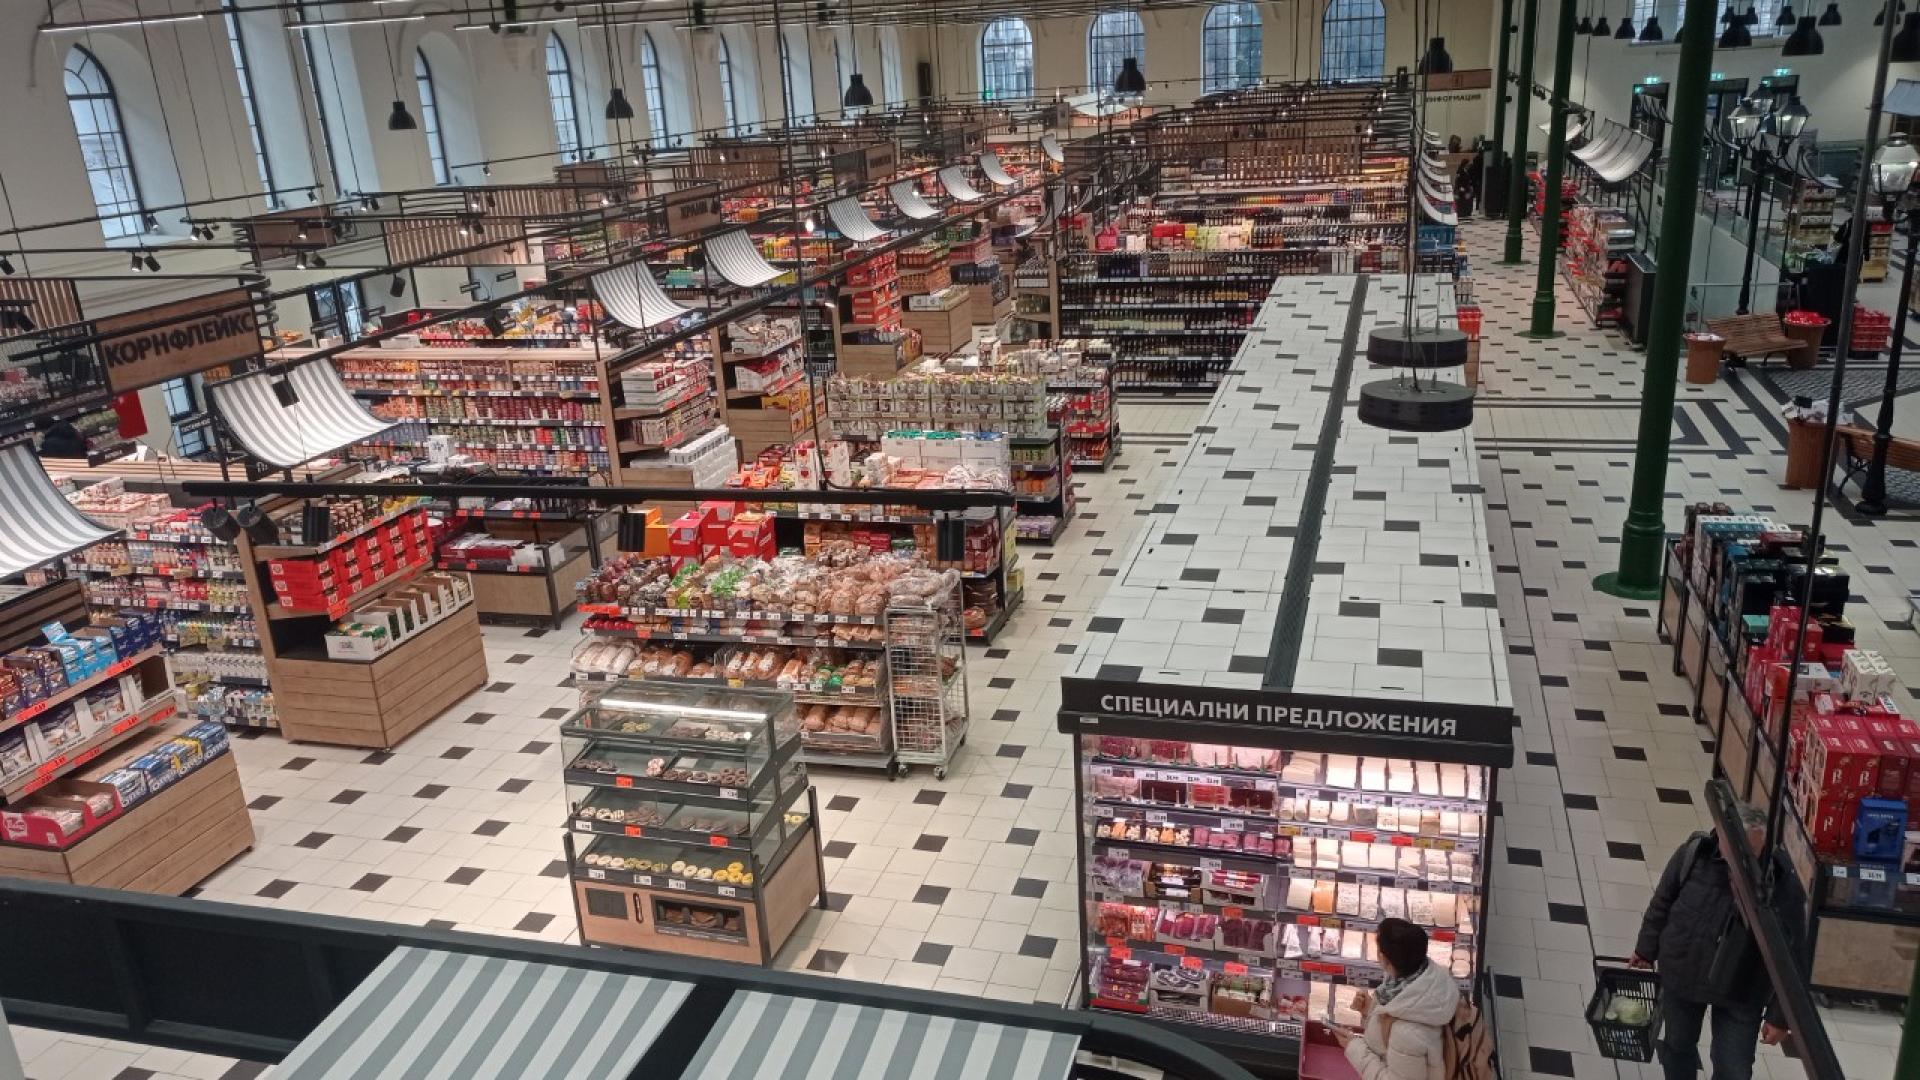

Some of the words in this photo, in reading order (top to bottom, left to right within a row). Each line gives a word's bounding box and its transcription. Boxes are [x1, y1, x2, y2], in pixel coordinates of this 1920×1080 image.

[104, 312, 254, 367] КОРНФЛЕЙКС
[1100, 694, 1249, 721] СПЕЦИАЛНИ
[1256, 704, 1457, 736] ПРЕДЛОЖЕНИЯ
